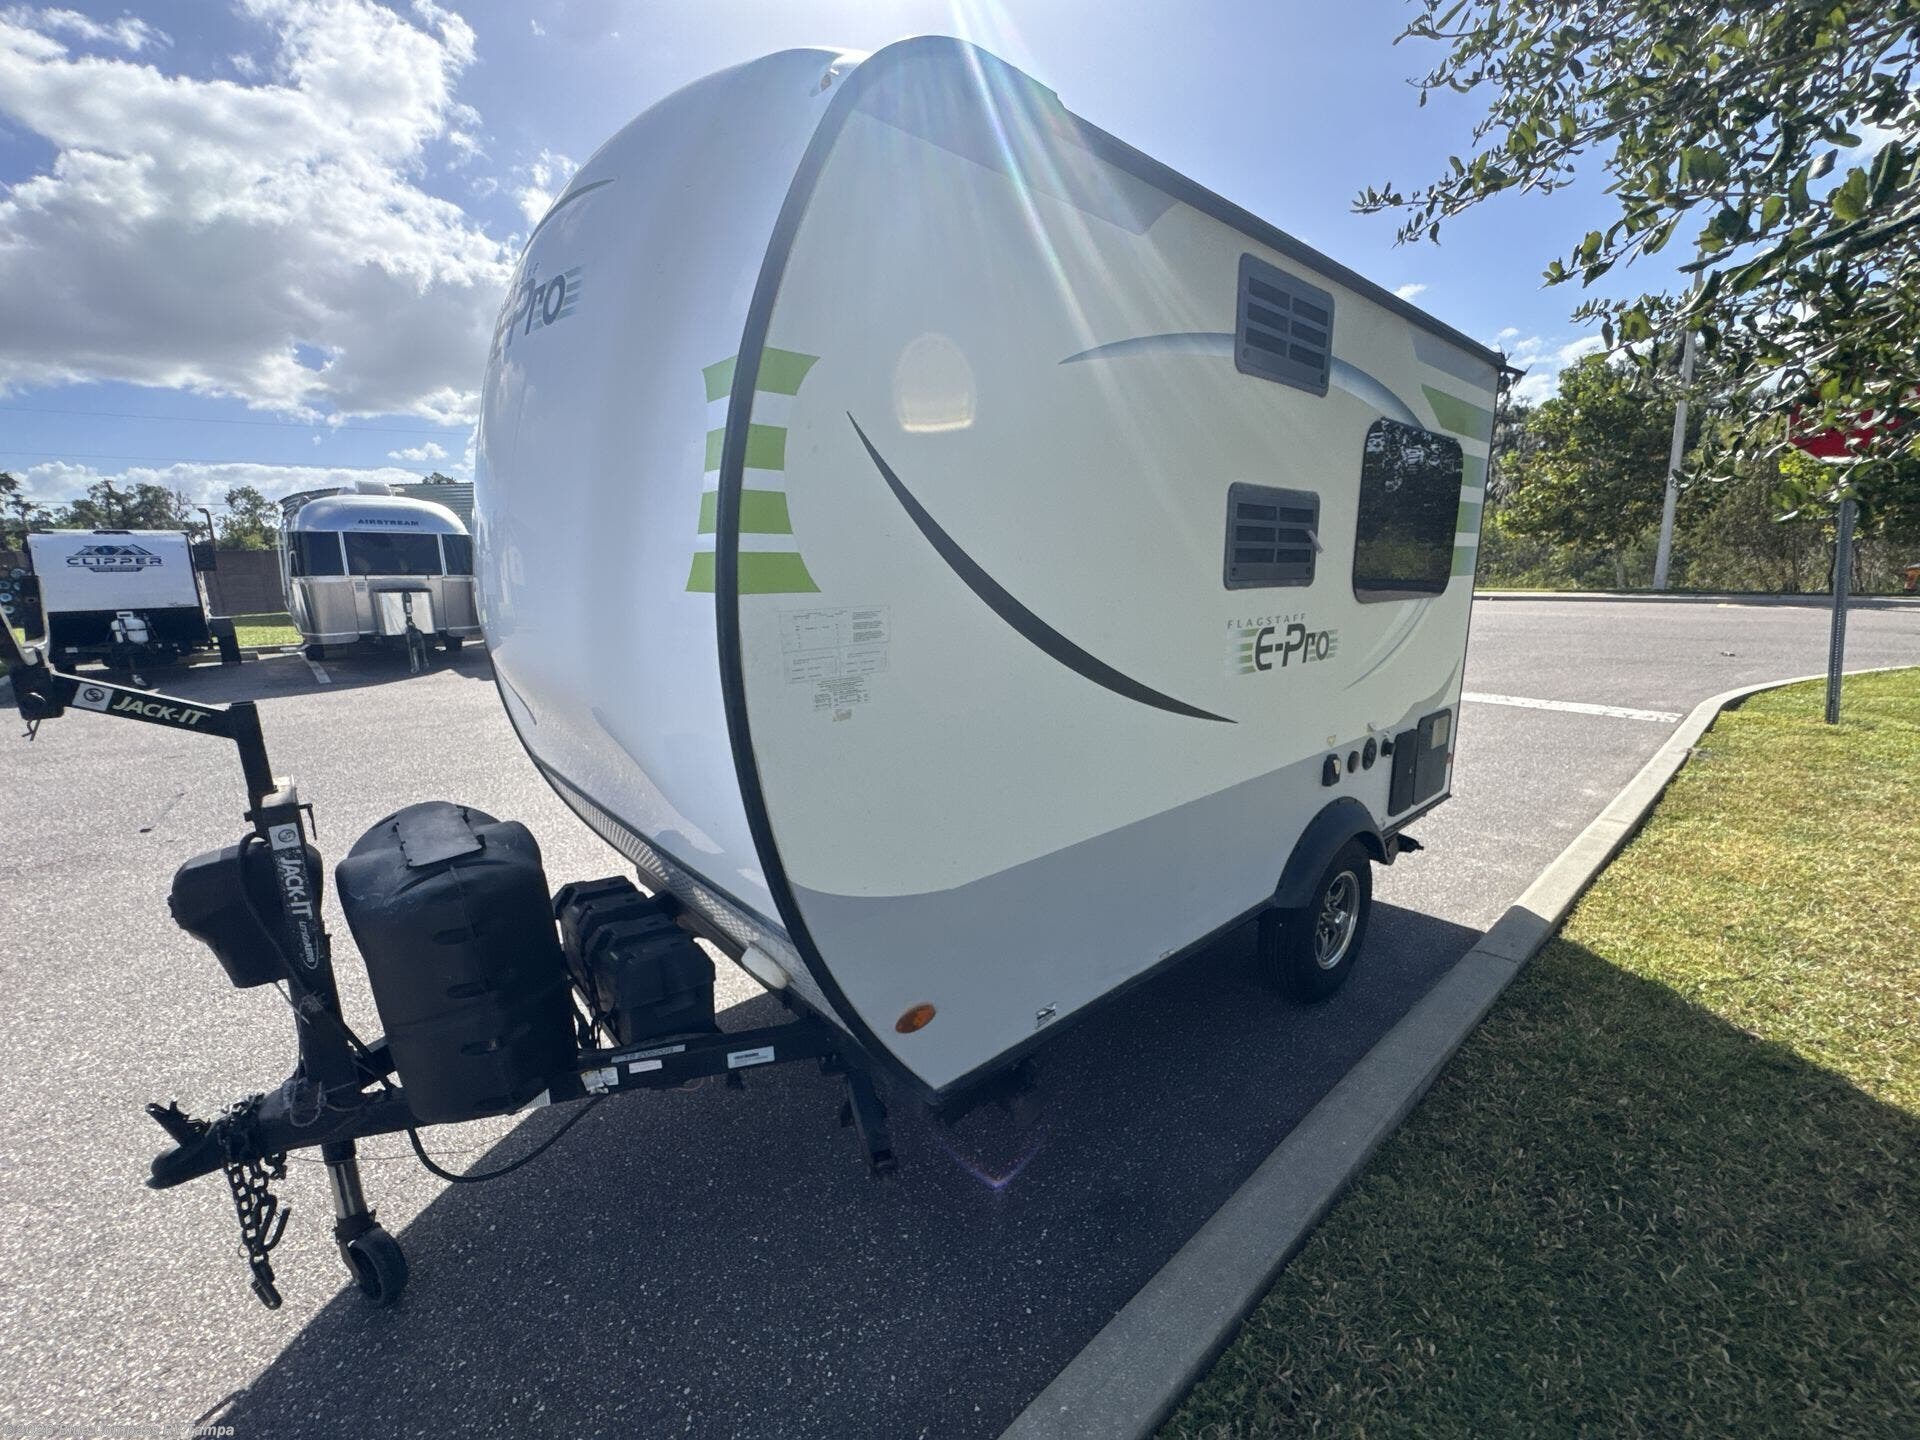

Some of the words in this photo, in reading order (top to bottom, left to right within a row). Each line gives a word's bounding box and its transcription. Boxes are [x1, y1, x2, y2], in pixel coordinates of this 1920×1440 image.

[66, 557, 162, 566] CLIPPER
[1227, 613, 1306, 629] FLAGSTAFF
[1255, 623, 1330, 671] E-Pro
[112, 696, 211, 725] JACK-IT
[279, 856, 313, 920] JACK-IT
